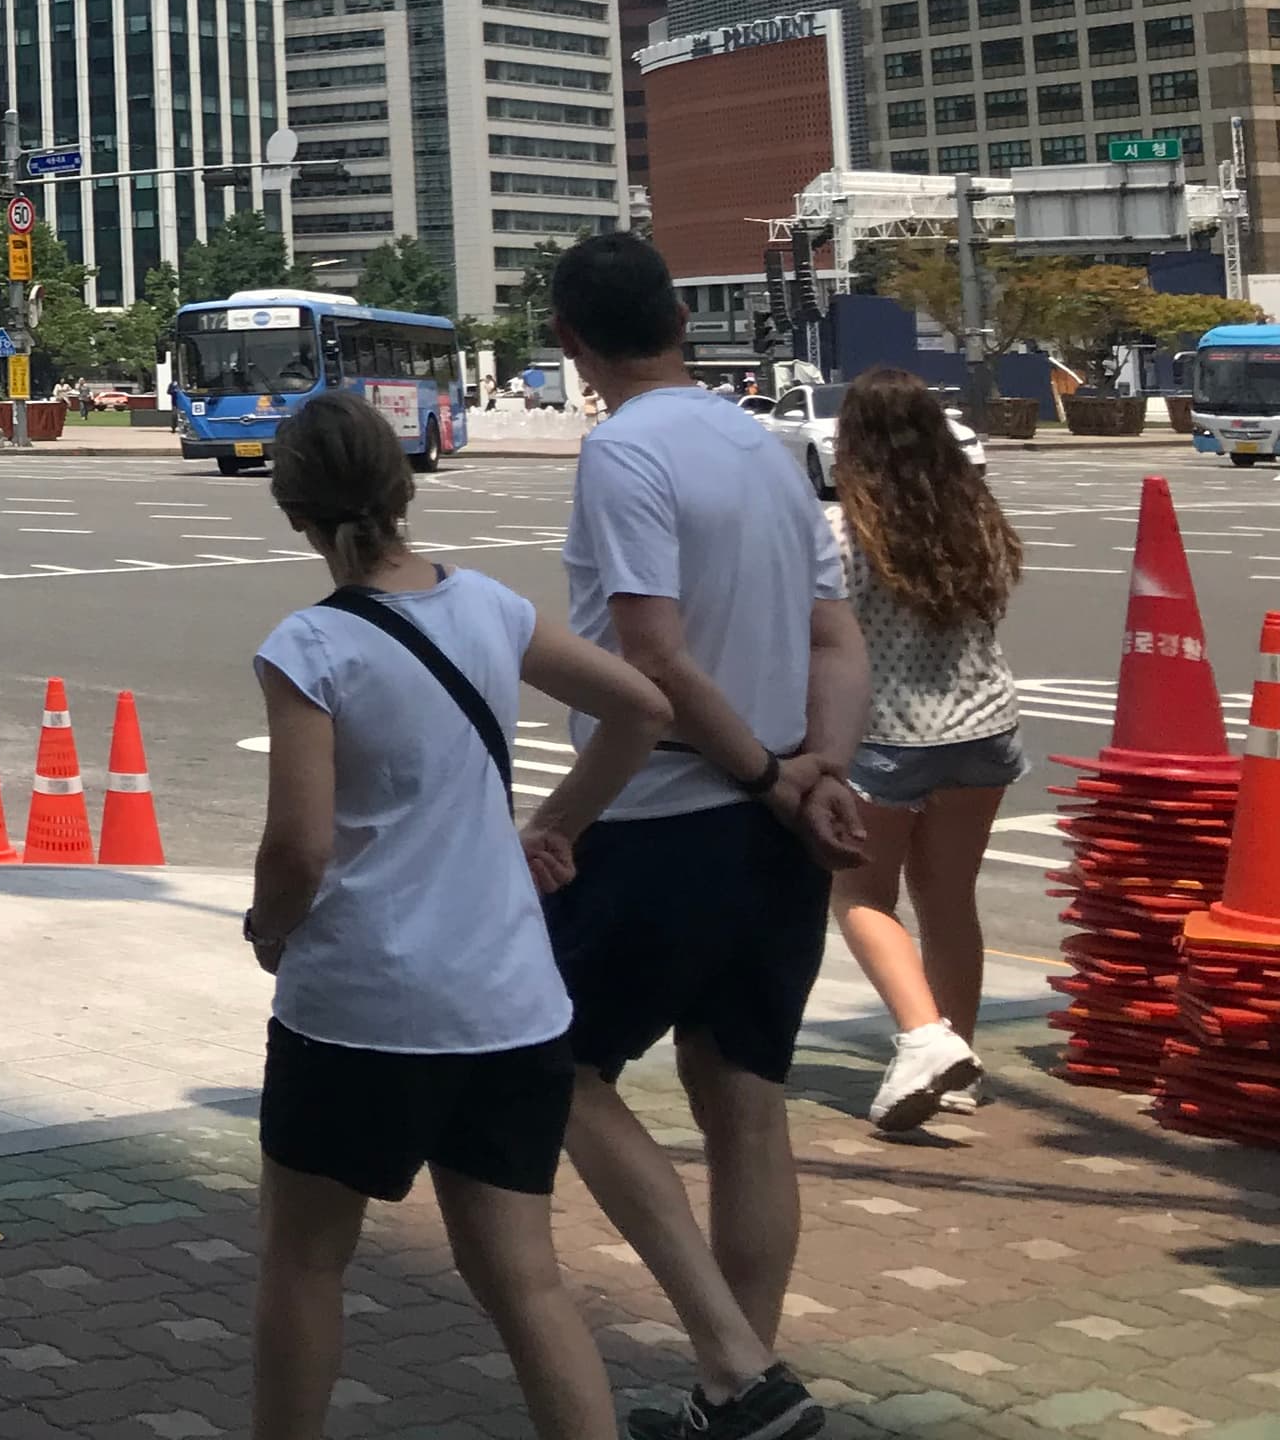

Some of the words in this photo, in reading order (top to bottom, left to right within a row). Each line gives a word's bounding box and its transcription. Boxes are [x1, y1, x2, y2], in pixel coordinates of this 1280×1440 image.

[723, 13, 816, 51] PRESIDENT
[1123, 142, 1167, 158] 시청
[14, 206, 29, 224] 50
